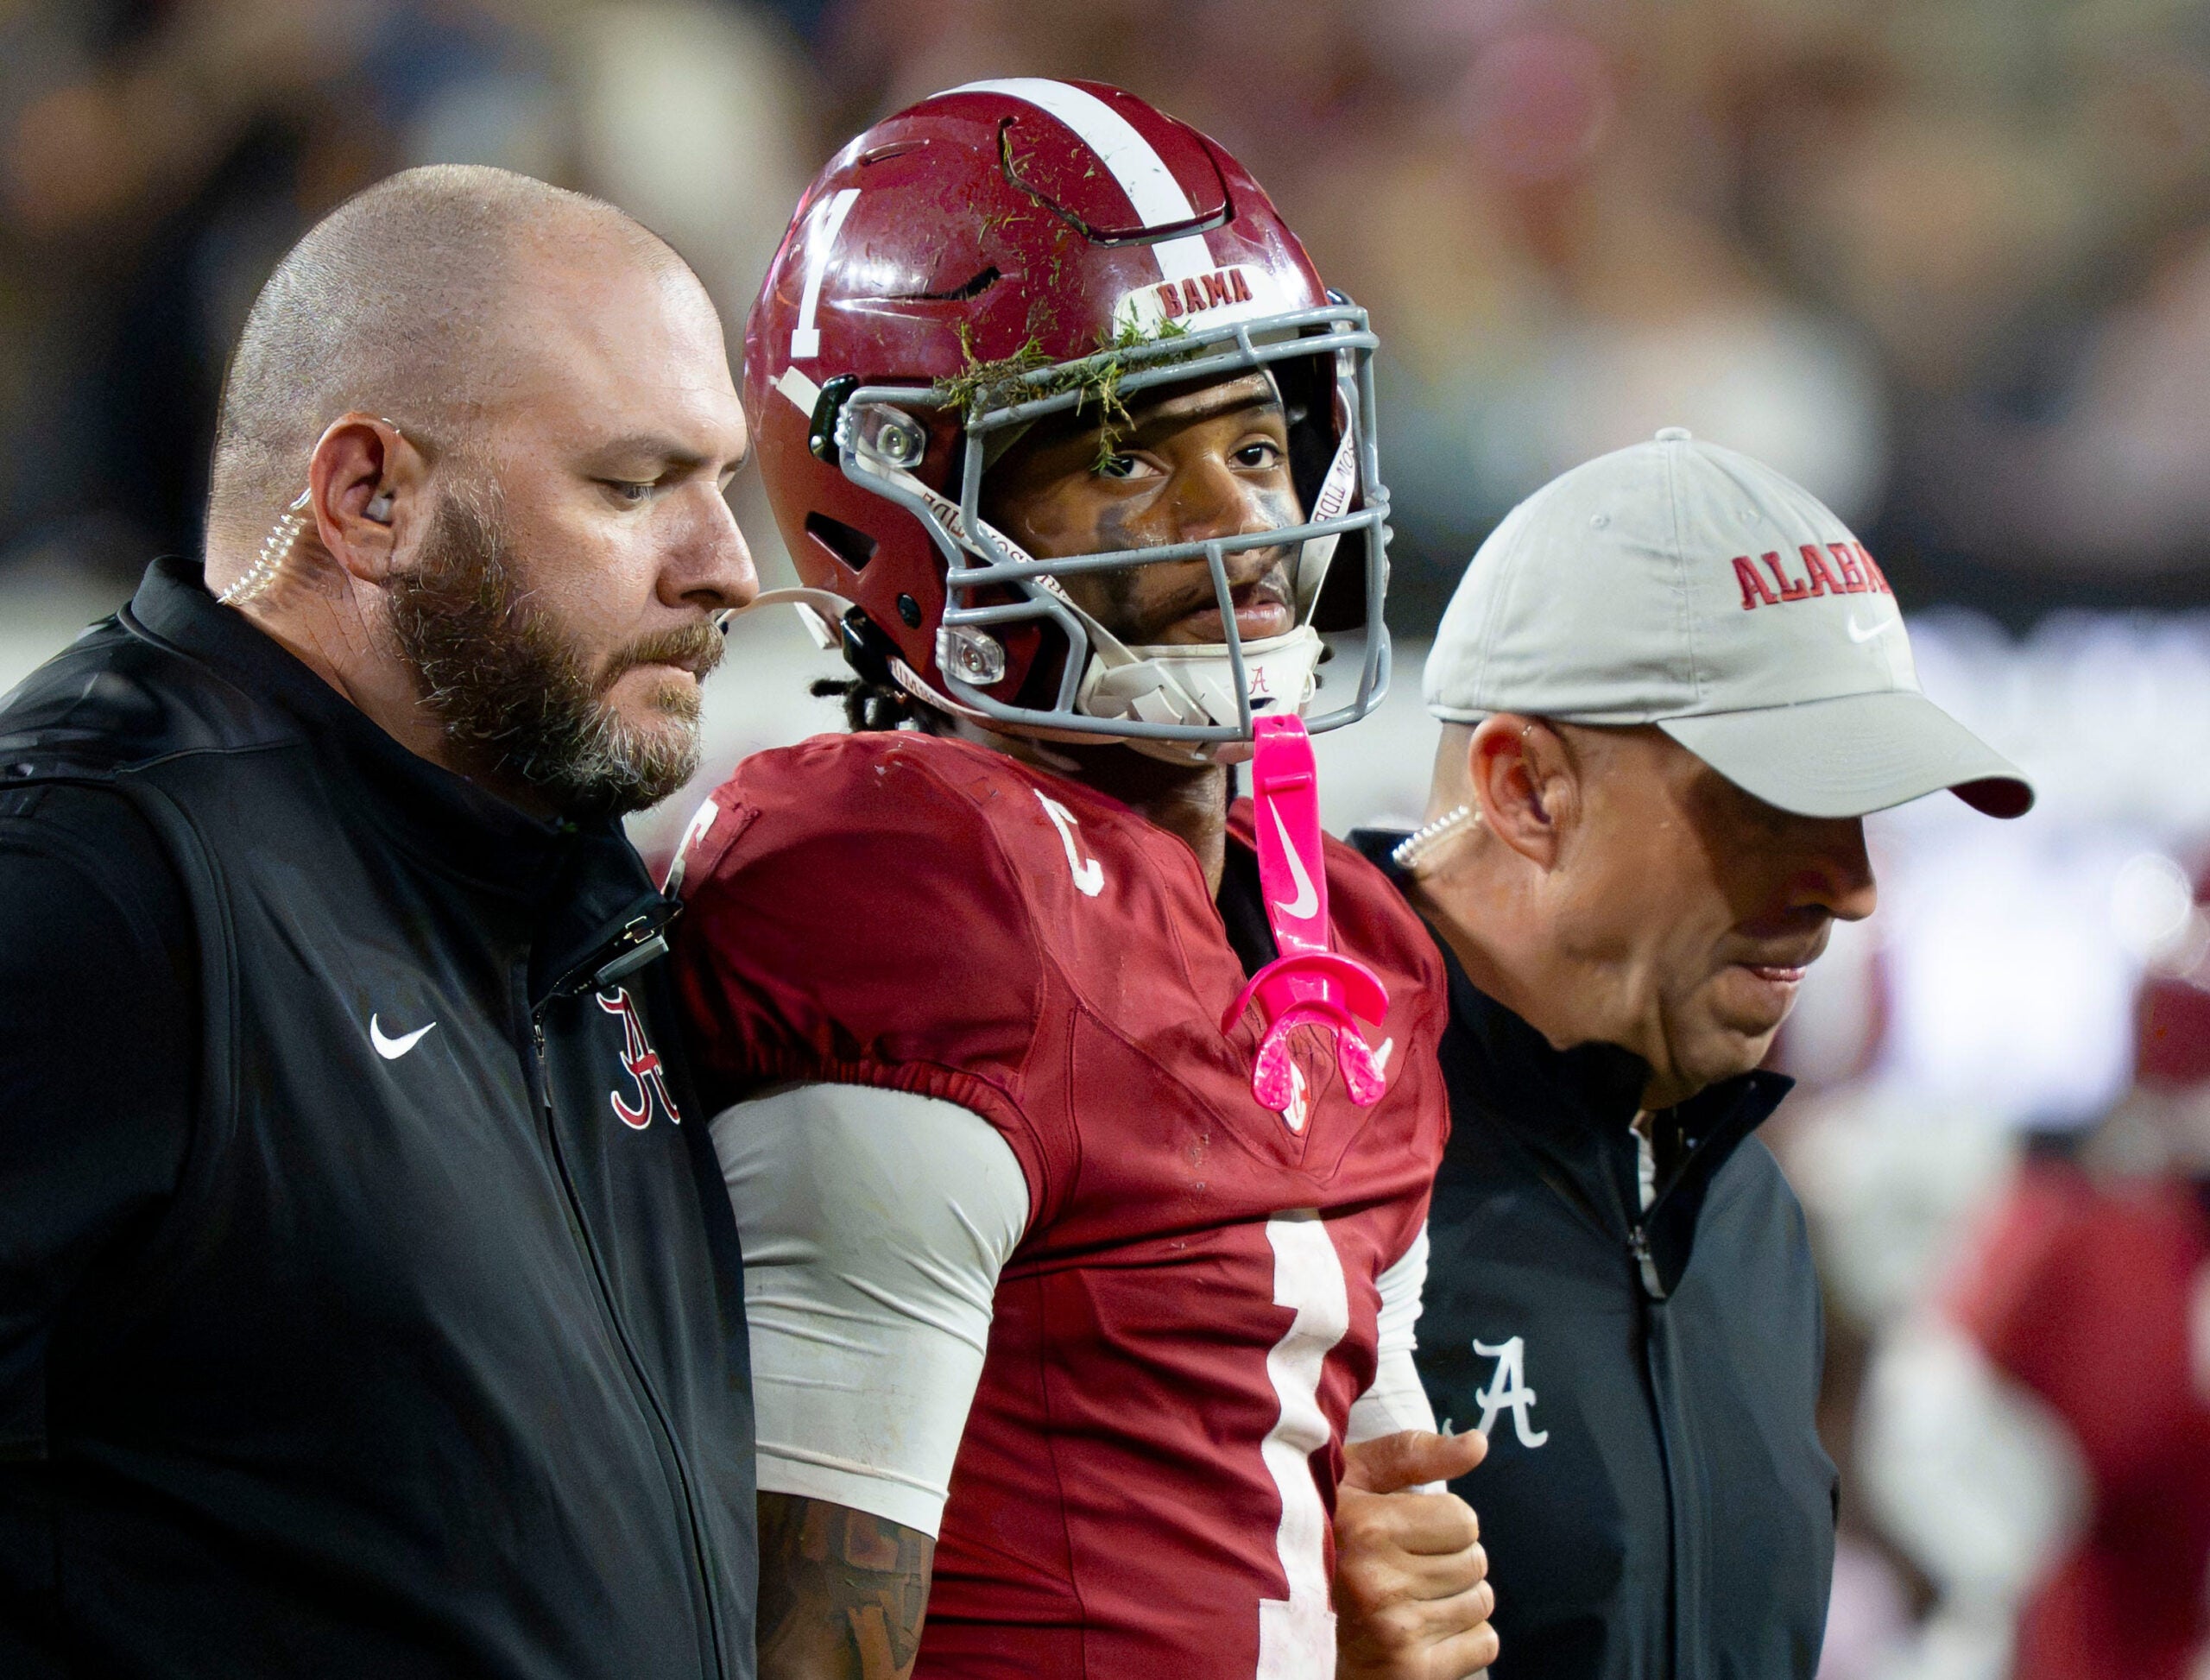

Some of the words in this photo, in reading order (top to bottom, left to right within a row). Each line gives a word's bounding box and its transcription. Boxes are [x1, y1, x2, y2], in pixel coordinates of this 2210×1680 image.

[790, 188, 862, 358] 1
[1155, 268, 1253, 319] BAMA
[1247, 666, 1270, 696] A
[1256, 1209, 1349, 1680] 1
[1442, 1336, 1549, 1449] A
